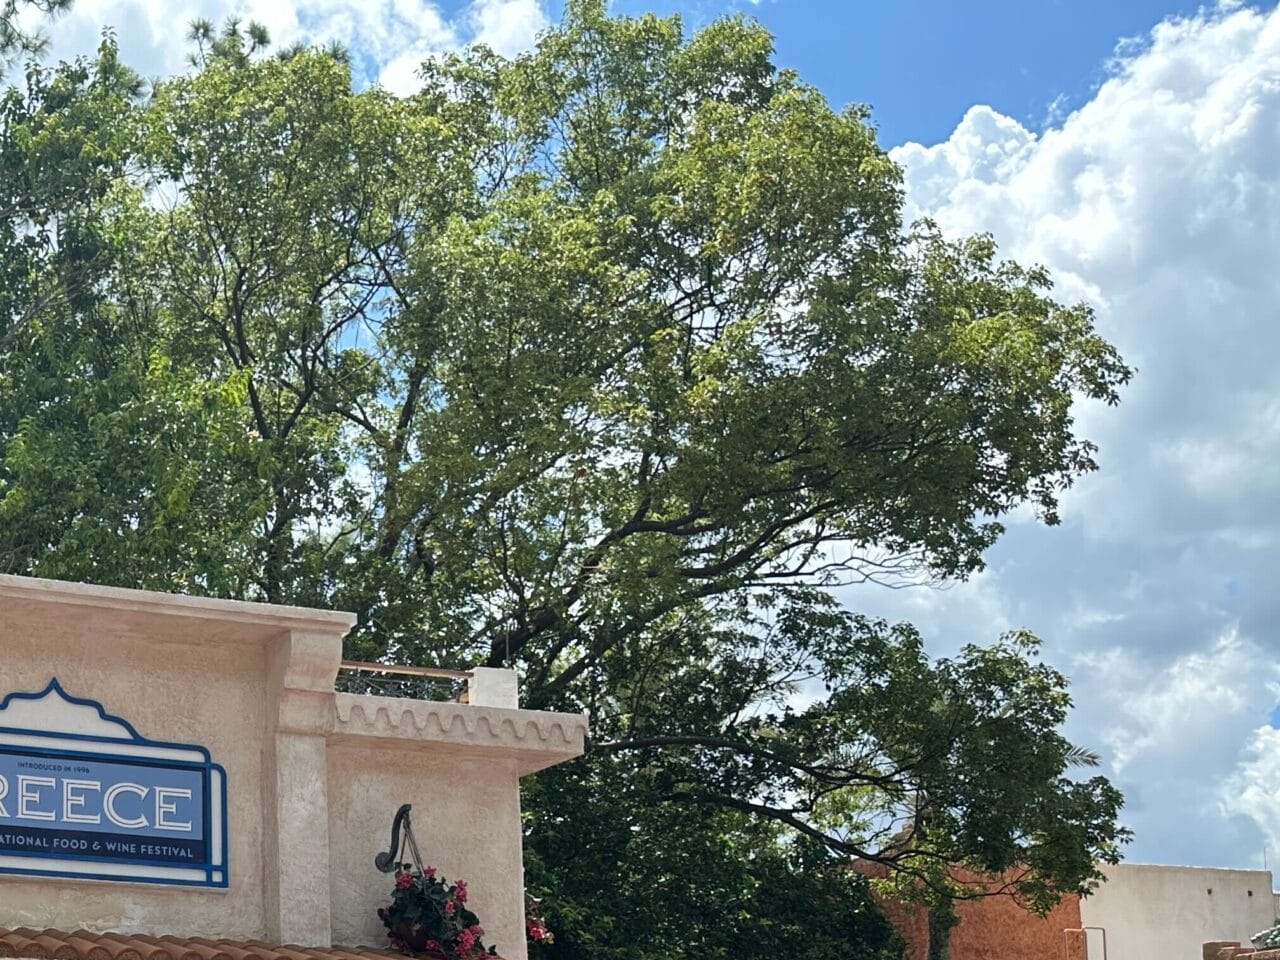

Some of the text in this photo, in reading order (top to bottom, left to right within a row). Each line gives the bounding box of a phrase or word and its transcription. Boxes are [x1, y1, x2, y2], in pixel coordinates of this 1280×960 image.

[17, 761, 63, 772] INTRODUCED
[53, 837, 87, 851] FOOD
[91, 841, 102, 851] &
[105, 842, 137, 854] WINE
[140, 844, 194, 858] FESTIVAL
